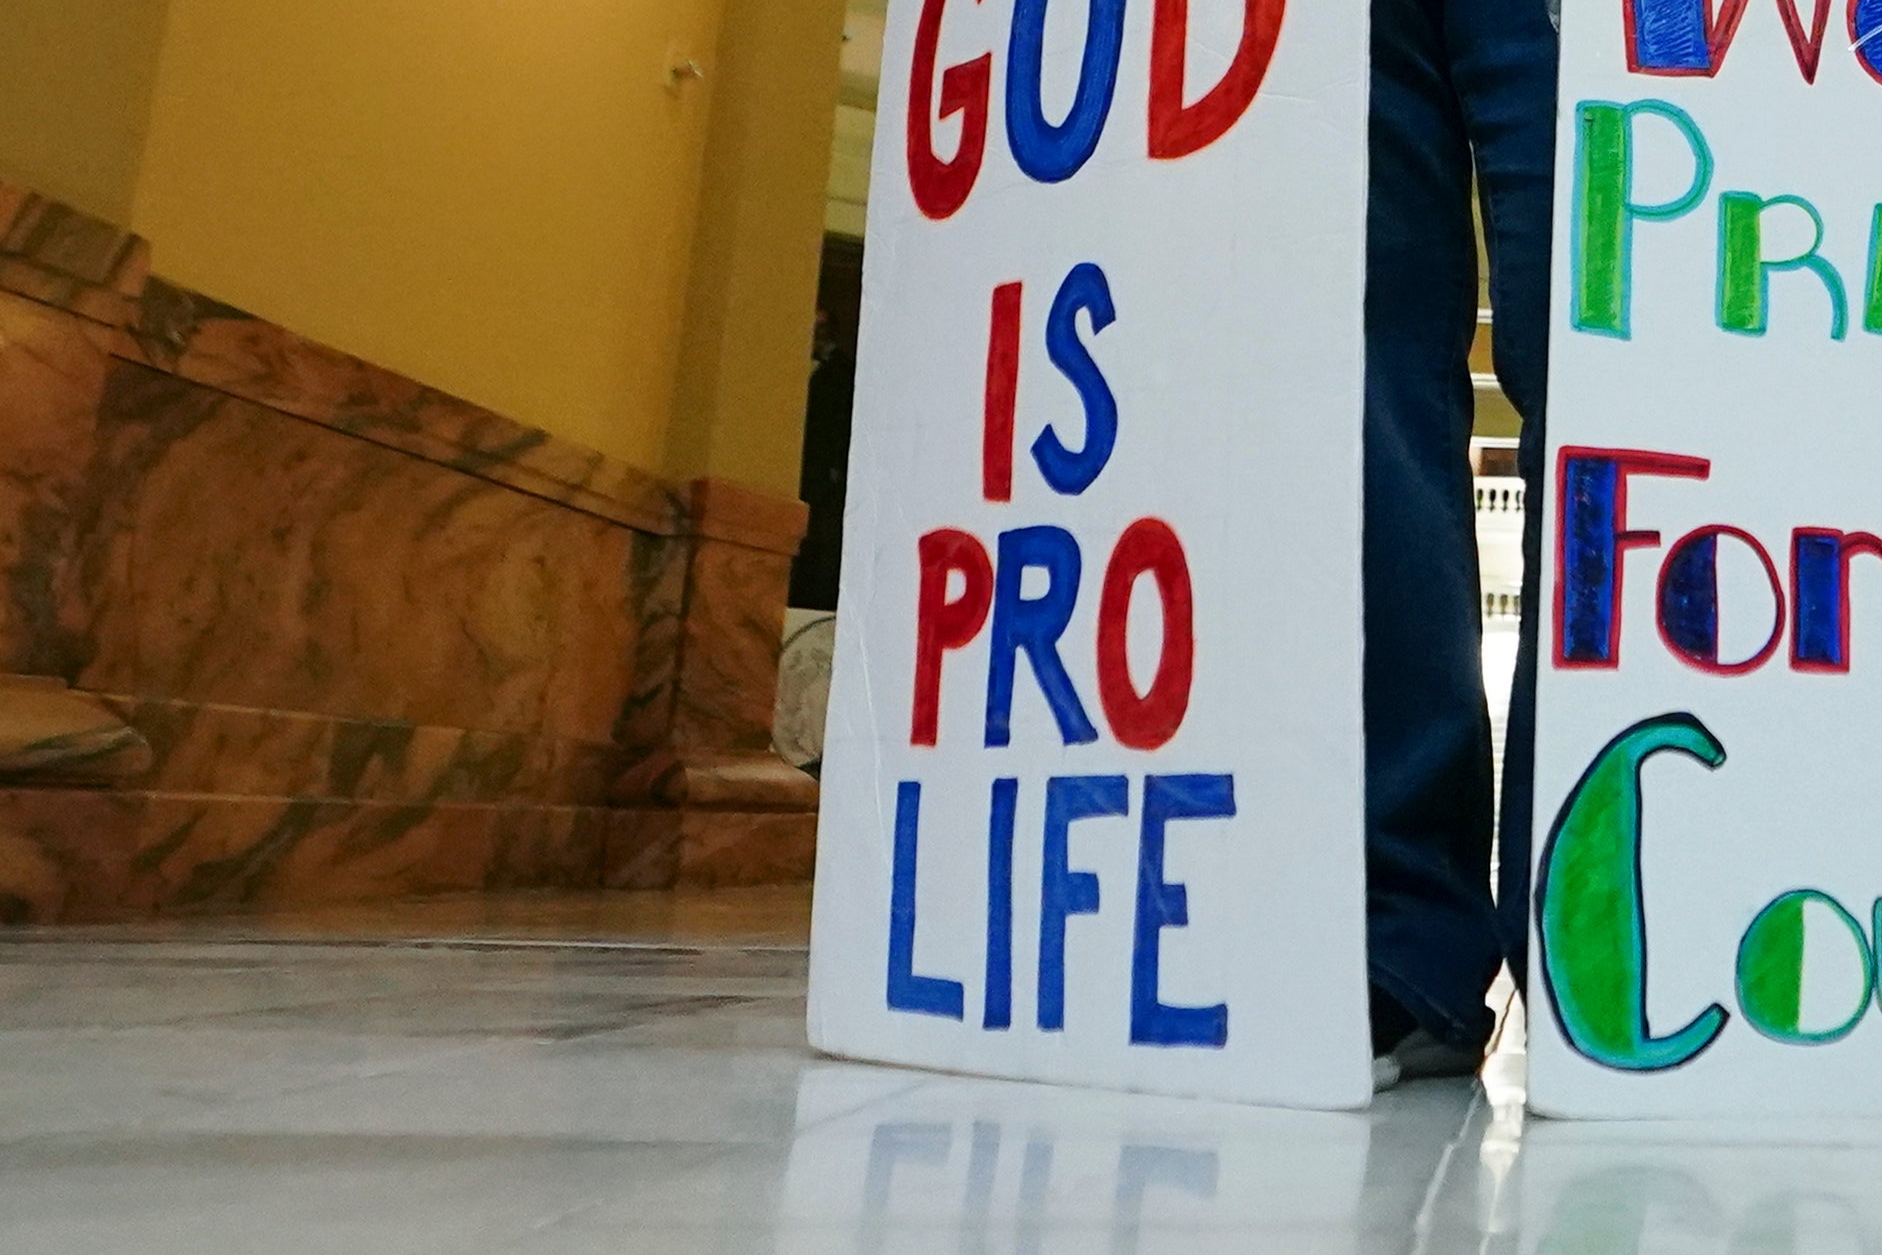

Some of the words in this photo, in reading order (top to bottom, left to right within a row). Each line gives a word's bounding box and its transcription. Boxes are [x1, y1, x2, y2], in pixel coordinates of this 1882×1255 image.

[983, 263, 1118, 503] IS
[911, 517, 1195, 751] PRO
[887, 774, 1236, 1048] LIFE
